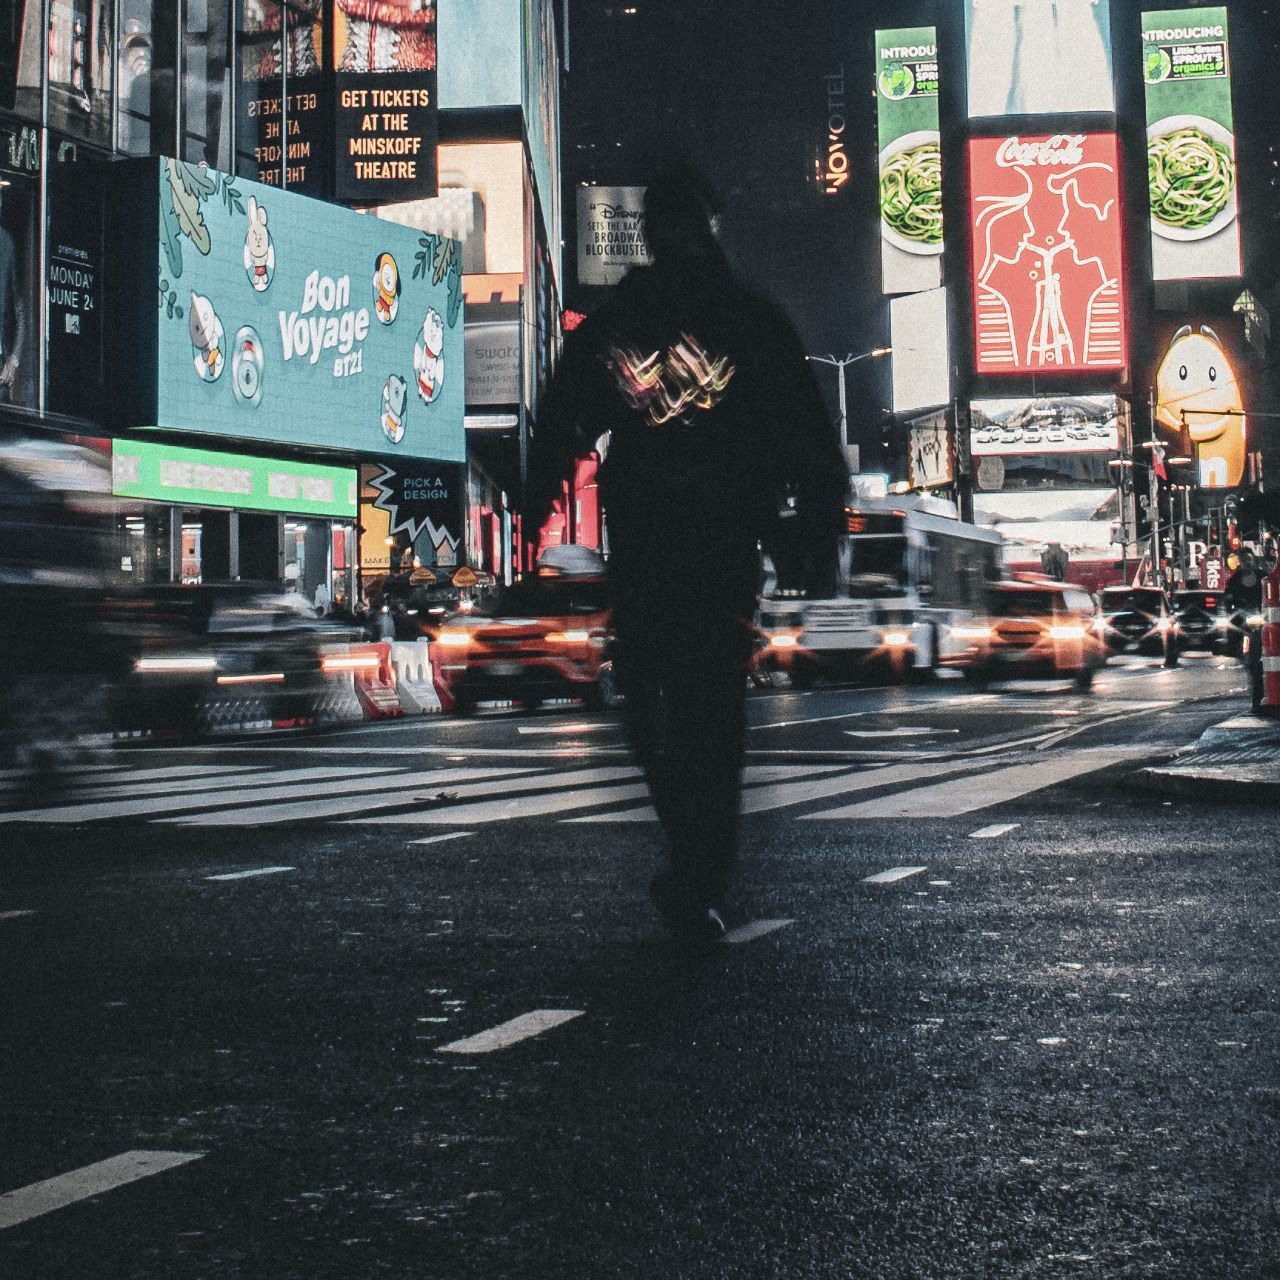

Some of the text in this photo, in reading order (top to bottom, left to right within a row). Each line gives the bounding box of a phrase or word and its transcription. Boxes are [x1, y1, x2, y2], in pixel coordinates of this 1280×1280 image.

[880, 45, 937, 59] INTRODU
[1173, 62, 1215, 73] organics
[341, 89, 430, 108] GET TICKETS
[361, 113, 409, 131] AT THE
[350, 137, 422, 156] MINSKOFF
[354, 161, 417, 179] THEATRE
[50, 265, 94, 289] MONDAY
[50, 288, 79, 308] JUNE
[301, 268, 350, 314] Bon
[279, 307, 370, 364] Voyage
[333, 348, 363, 377] BT21
[403, 477, 443, 488] PICK A
[403, 489, 448, 500] DESIGN
